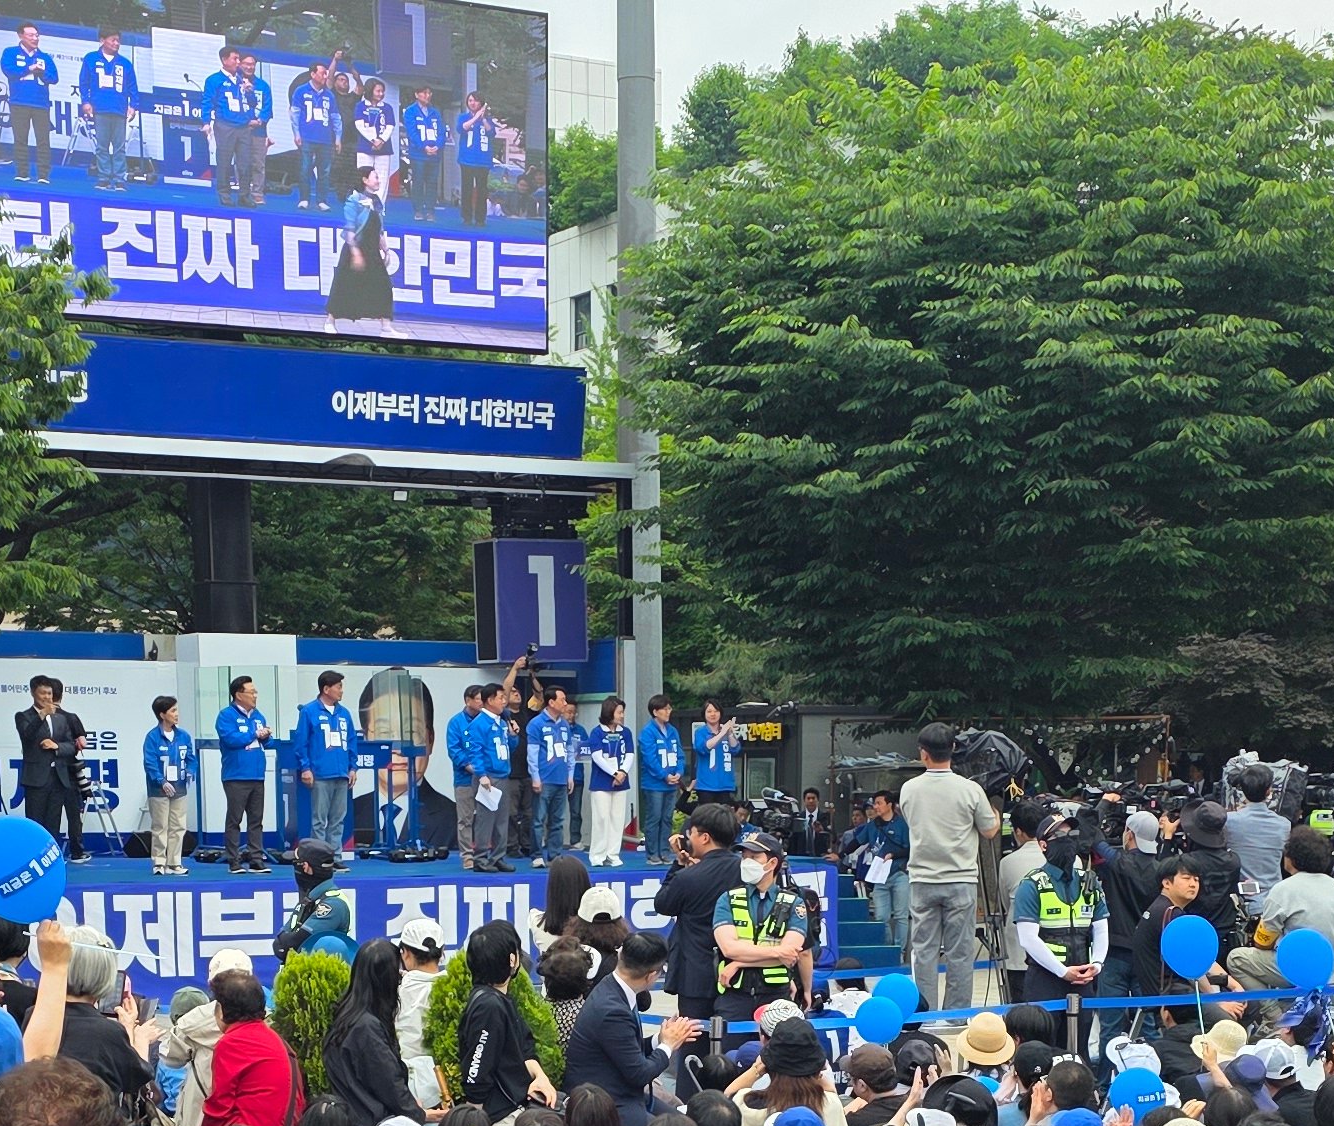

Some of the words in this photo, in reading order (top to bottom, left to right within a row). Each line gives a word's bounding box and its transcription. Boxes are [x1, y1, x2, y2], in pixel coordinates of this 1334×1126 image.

[154, 104, 181, 116] 지금은
[100, 207, 259, 290] 진짜
[331, 389, 420, 423] 이제부터
[423, 396, 469, 425] 진짜
[470, 399, 556, 430] 대한민국
[527, 555, 556, 647] 1
[103, 686, 117, 695] 후보
[0, 871, 34, 895] 지금은
[28, 858, 45, 877] 1
